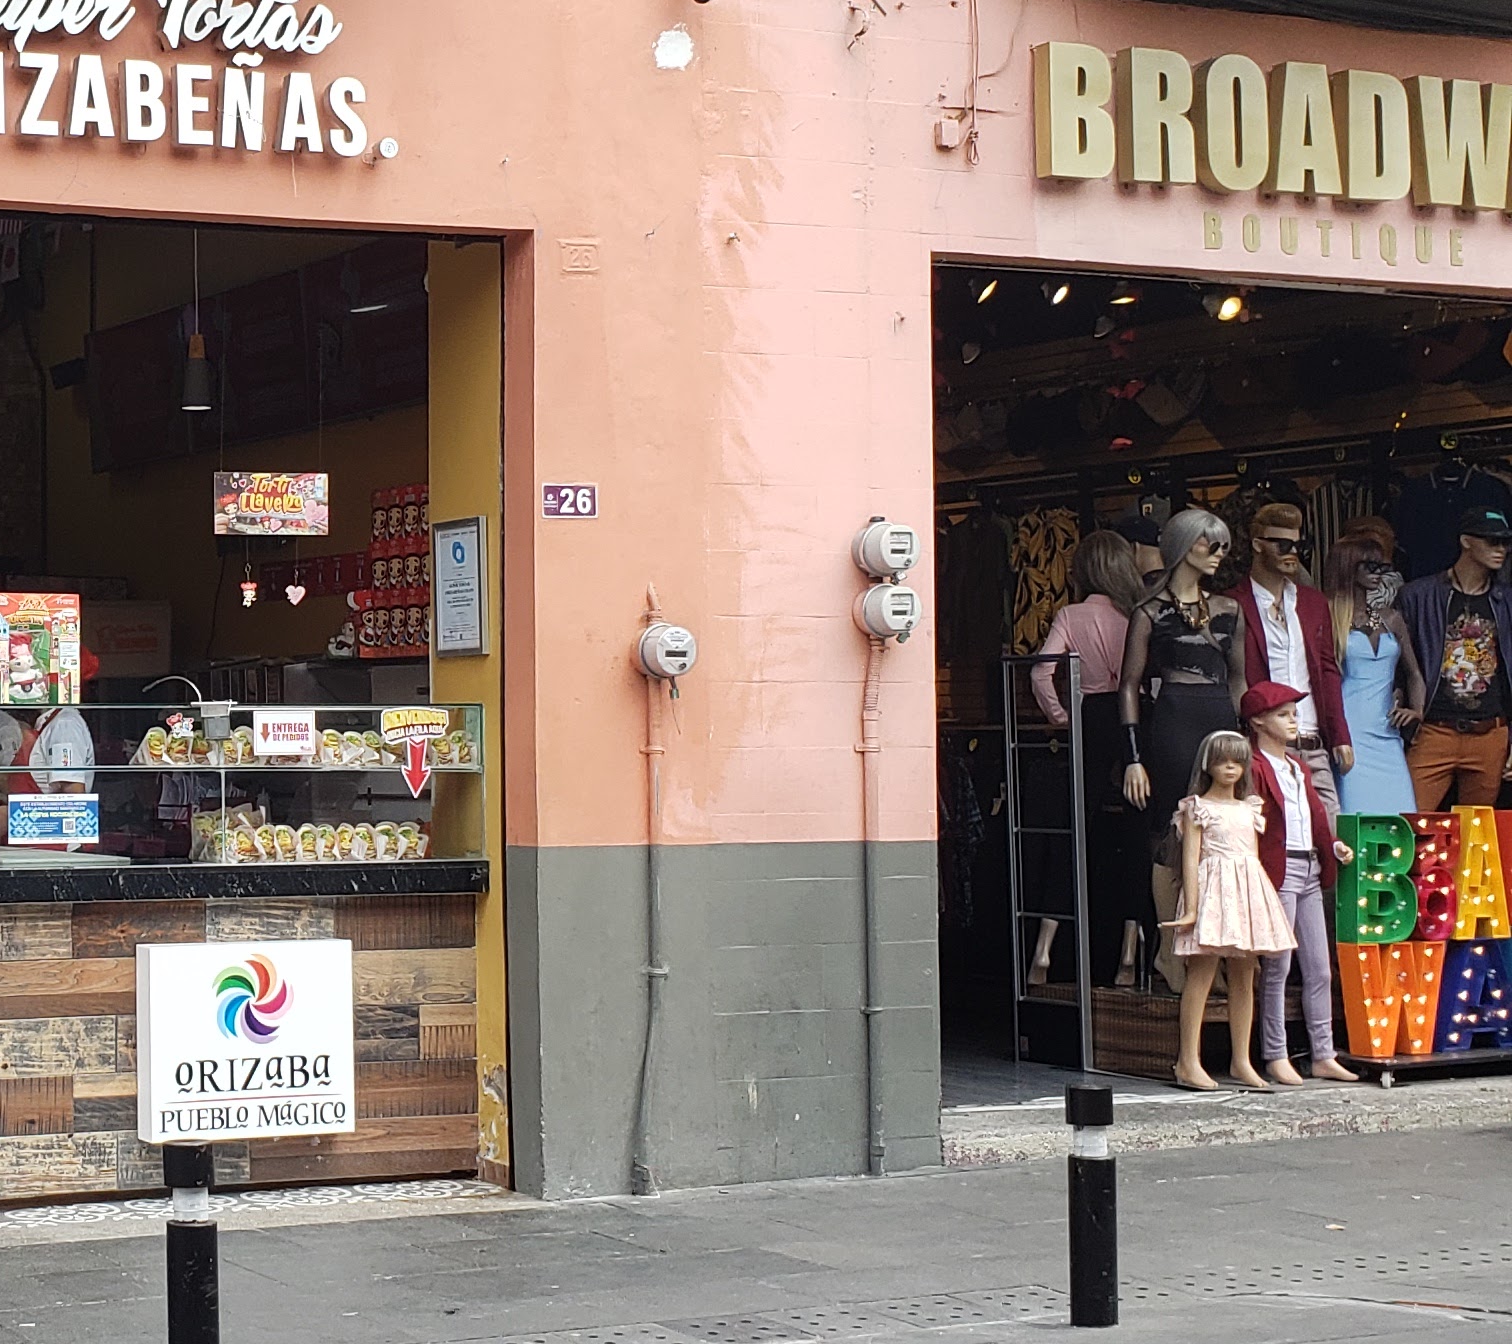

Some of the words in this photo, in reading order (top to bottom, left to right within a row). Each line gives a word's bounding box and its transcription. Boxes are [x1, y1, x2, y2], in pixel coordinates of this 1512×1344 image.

[1203, 211, 1464, 266] BOUTIQUE
[559, 487, 592, 514] 26
[271, 722, 310, 733] ENTREGA
